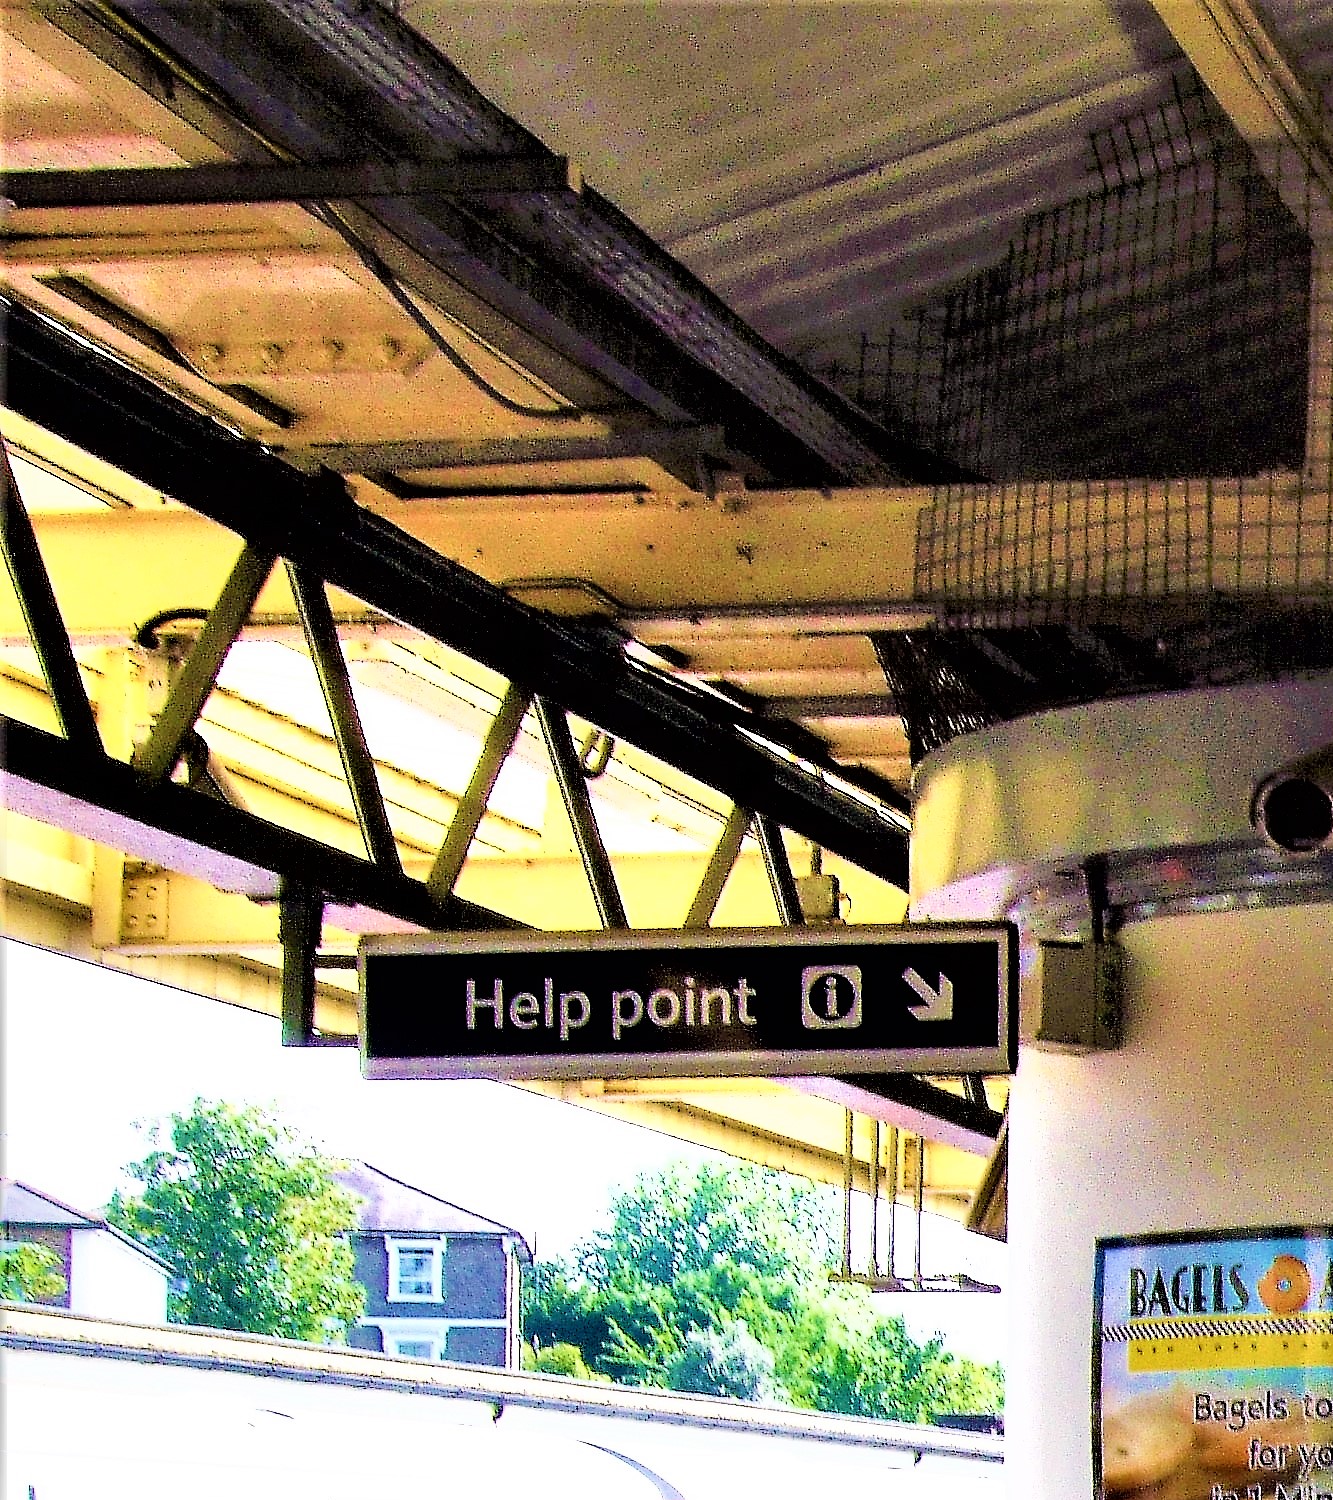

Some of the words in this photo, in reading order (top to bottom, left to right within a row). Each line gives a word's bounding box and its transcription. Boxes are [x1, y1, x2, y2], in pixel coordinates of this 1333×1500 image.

[466, 976, 591, 1042] Help
[612, 975, 757, 1041] point
[1129, 1263, 1249, 1317] BAGELS
[1195, 1391, 1290, 1431] Bagels
[1249, 1438, 1286, 1470] for
